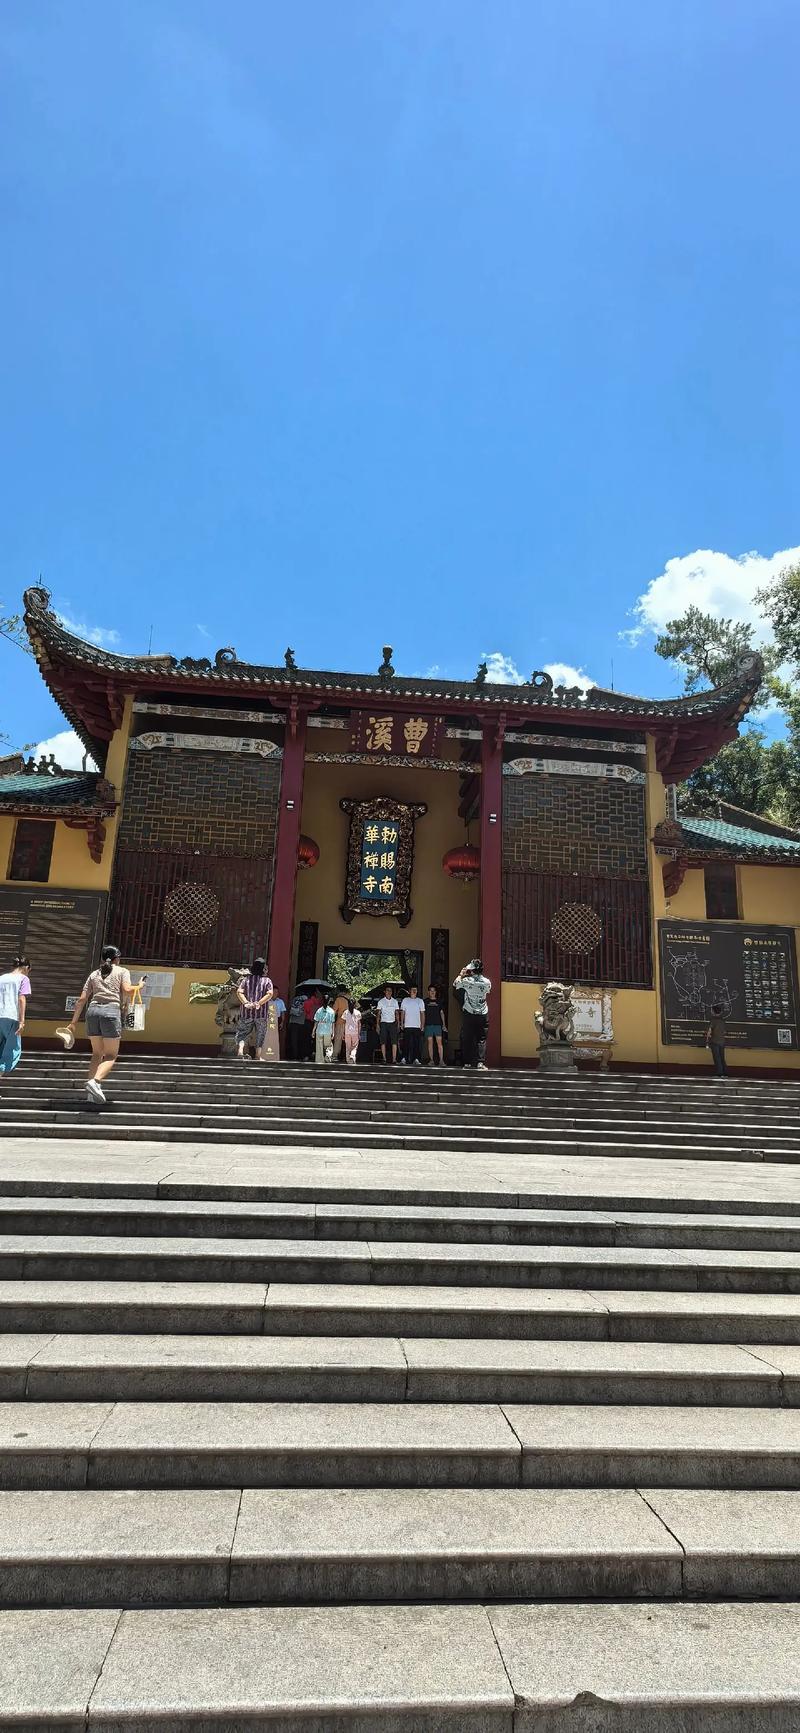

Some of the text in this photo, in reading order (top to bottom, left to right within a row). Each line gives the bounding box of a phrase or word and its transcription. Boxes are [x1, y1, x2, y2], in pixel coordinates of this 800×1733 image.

[365, 716, 429, 754] 曹溪
[362, 824, 380, 894] 華禪寺
